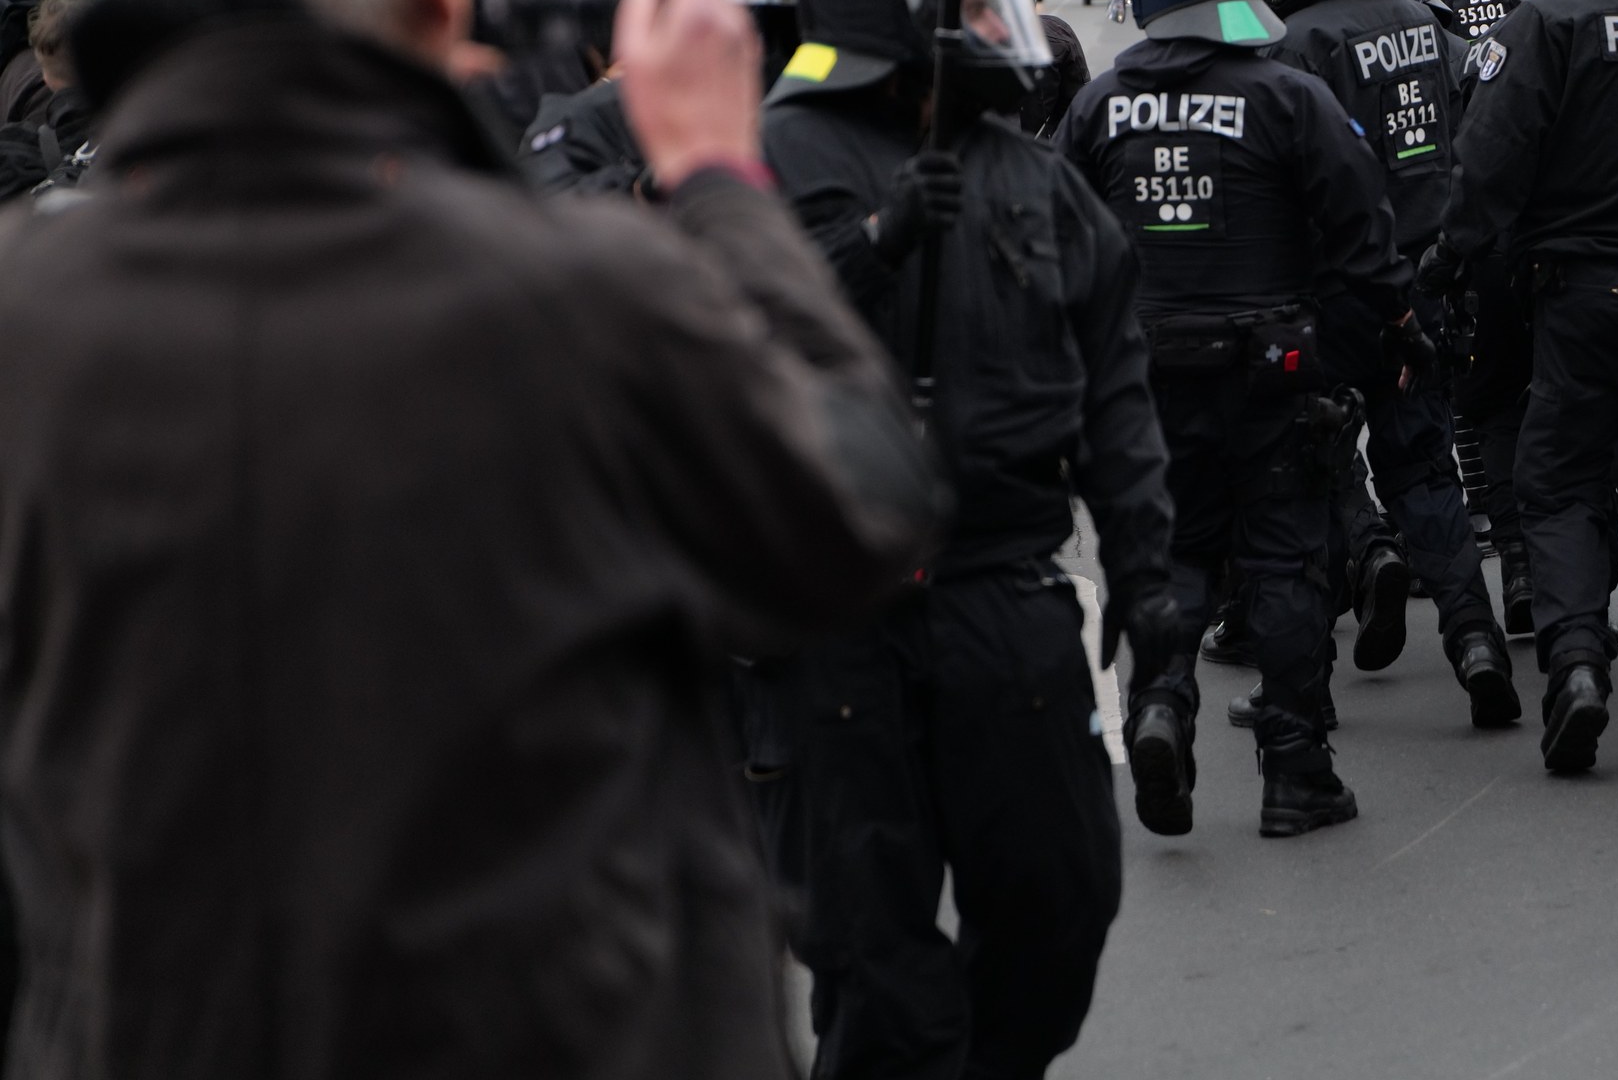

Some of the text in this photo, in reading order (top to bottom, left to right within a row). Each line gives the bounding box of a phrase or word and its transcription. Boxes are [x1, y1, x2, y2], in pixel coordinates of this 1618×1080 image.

[1458, 3, 1507, 24] 35101
[1354, 24, 1439, 79] POLIZEI
[1398, 80, 1422, 106] BE
[1108, 92, 1246, 138] POLIZEI
[1386, 103, 1437, 135] 35111
[1154, 146, 1190, 172] BE
[1134, 175, 1213, 202] 35110
